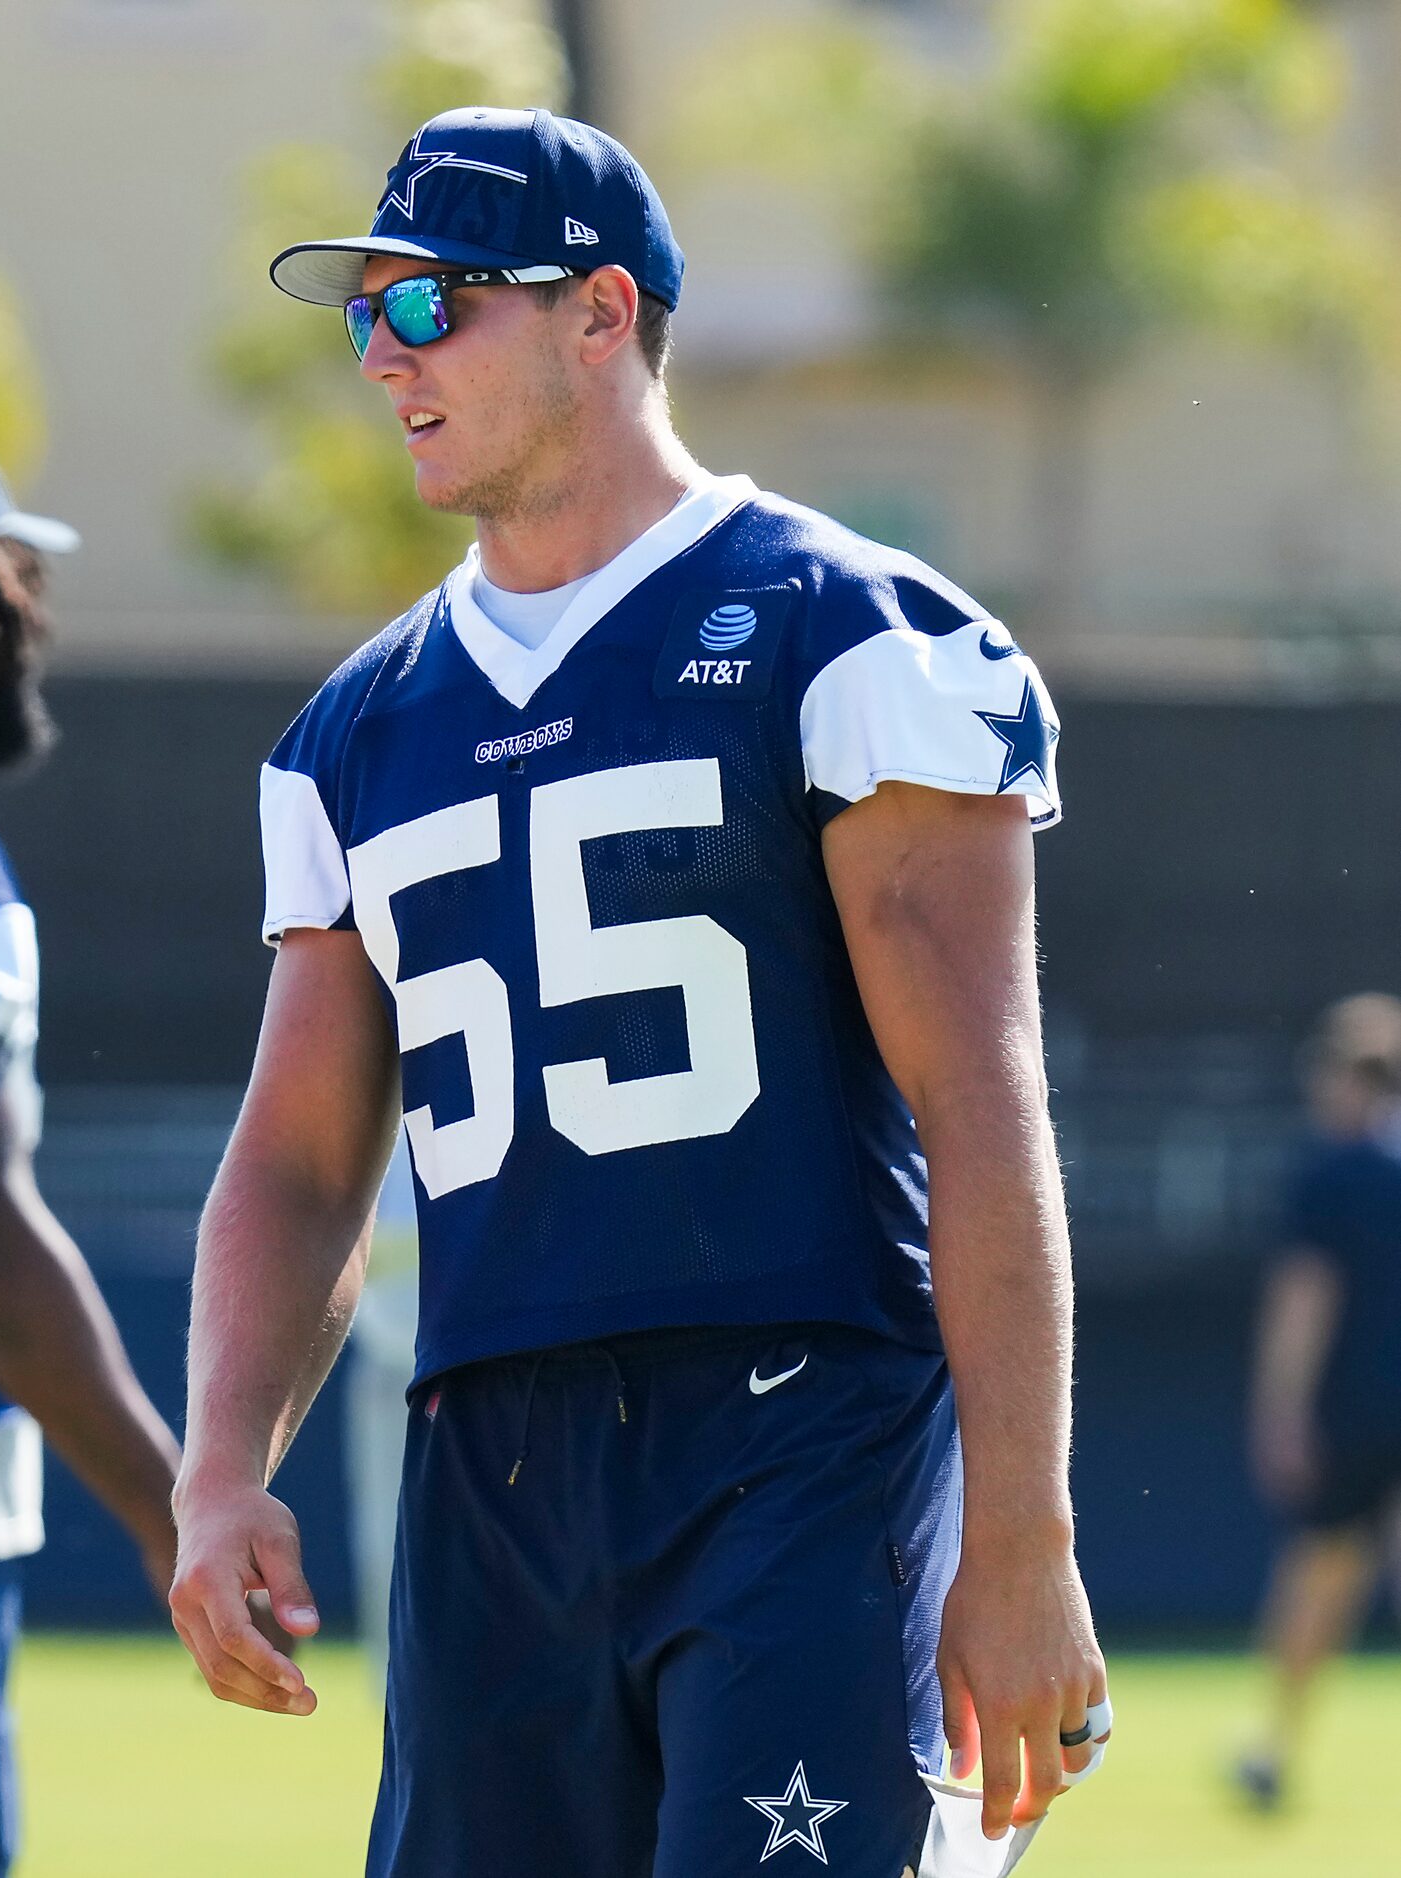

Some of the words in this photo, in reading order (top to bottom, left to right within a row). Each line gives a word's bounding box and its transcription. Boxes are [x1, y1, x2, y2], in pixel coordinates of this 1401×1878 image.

[678, 660, 751, 684] AT&T
[475, 717, 573, 763] COWBOYS
[346, 757, 760, 1200] 55
